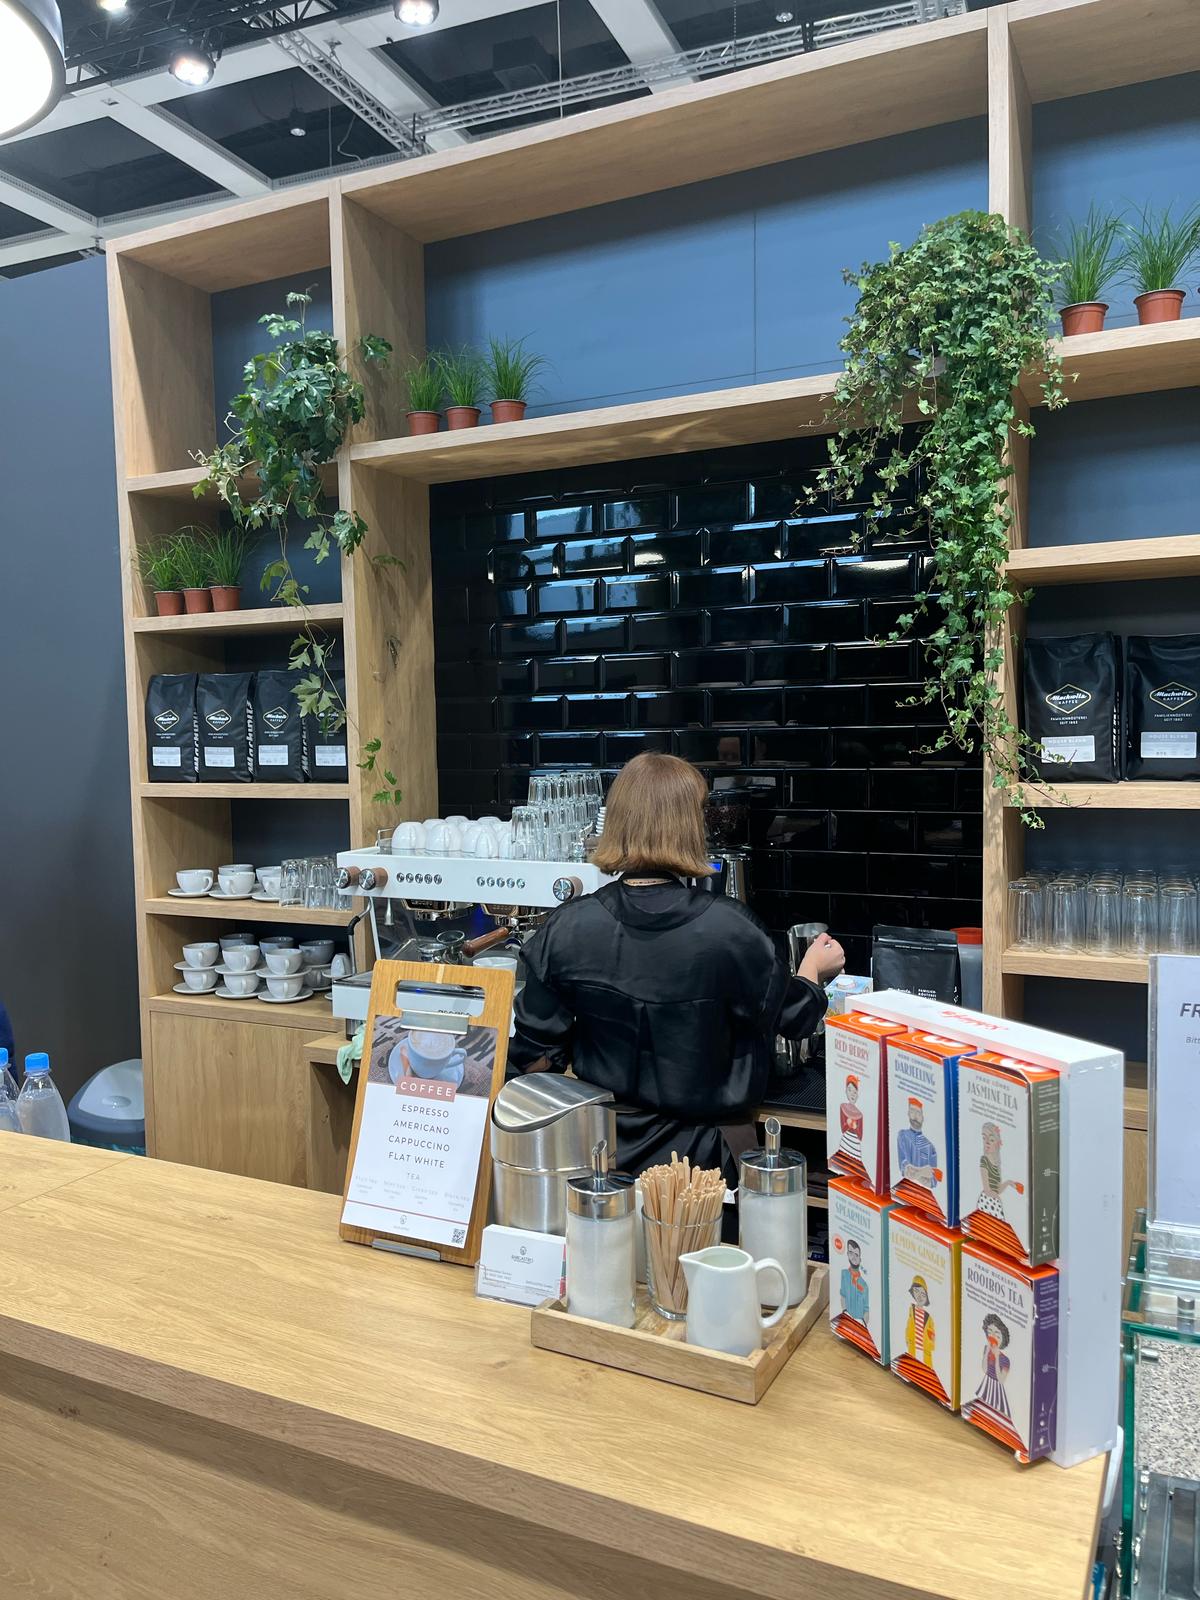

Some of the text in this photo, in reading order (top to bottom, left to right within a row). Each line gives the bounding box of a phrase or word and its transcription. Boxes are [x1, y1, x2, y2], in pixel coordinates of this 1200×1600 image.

[834, 1038, 848, 1053] RED
[848, 1042, 869, 1062] BERRY
[894, 1058, 936, 1086] DARJEELING
[400, 1081, 453, 1097] COFFEE
[967, 1080, 1001, 1105] JASMINE
[1002, 1091, 1018, 1111] TEA
[401, 1104, 450, 1118] ESPRESSO
[393, 1119, 450, 1135] AMERICANO
[388, 1135, 450, 1152] CAPPUCCINO
[388, 1151, 446, 1169] FLAT WHITE
[406, 1172, 421, 1181] TEA
[835, 1202, 872, 1230] SPEARMINT
[967, 1267, 1006, 1298] ROOIBOS
[1008, 1287, 1025, 1309] TEA
